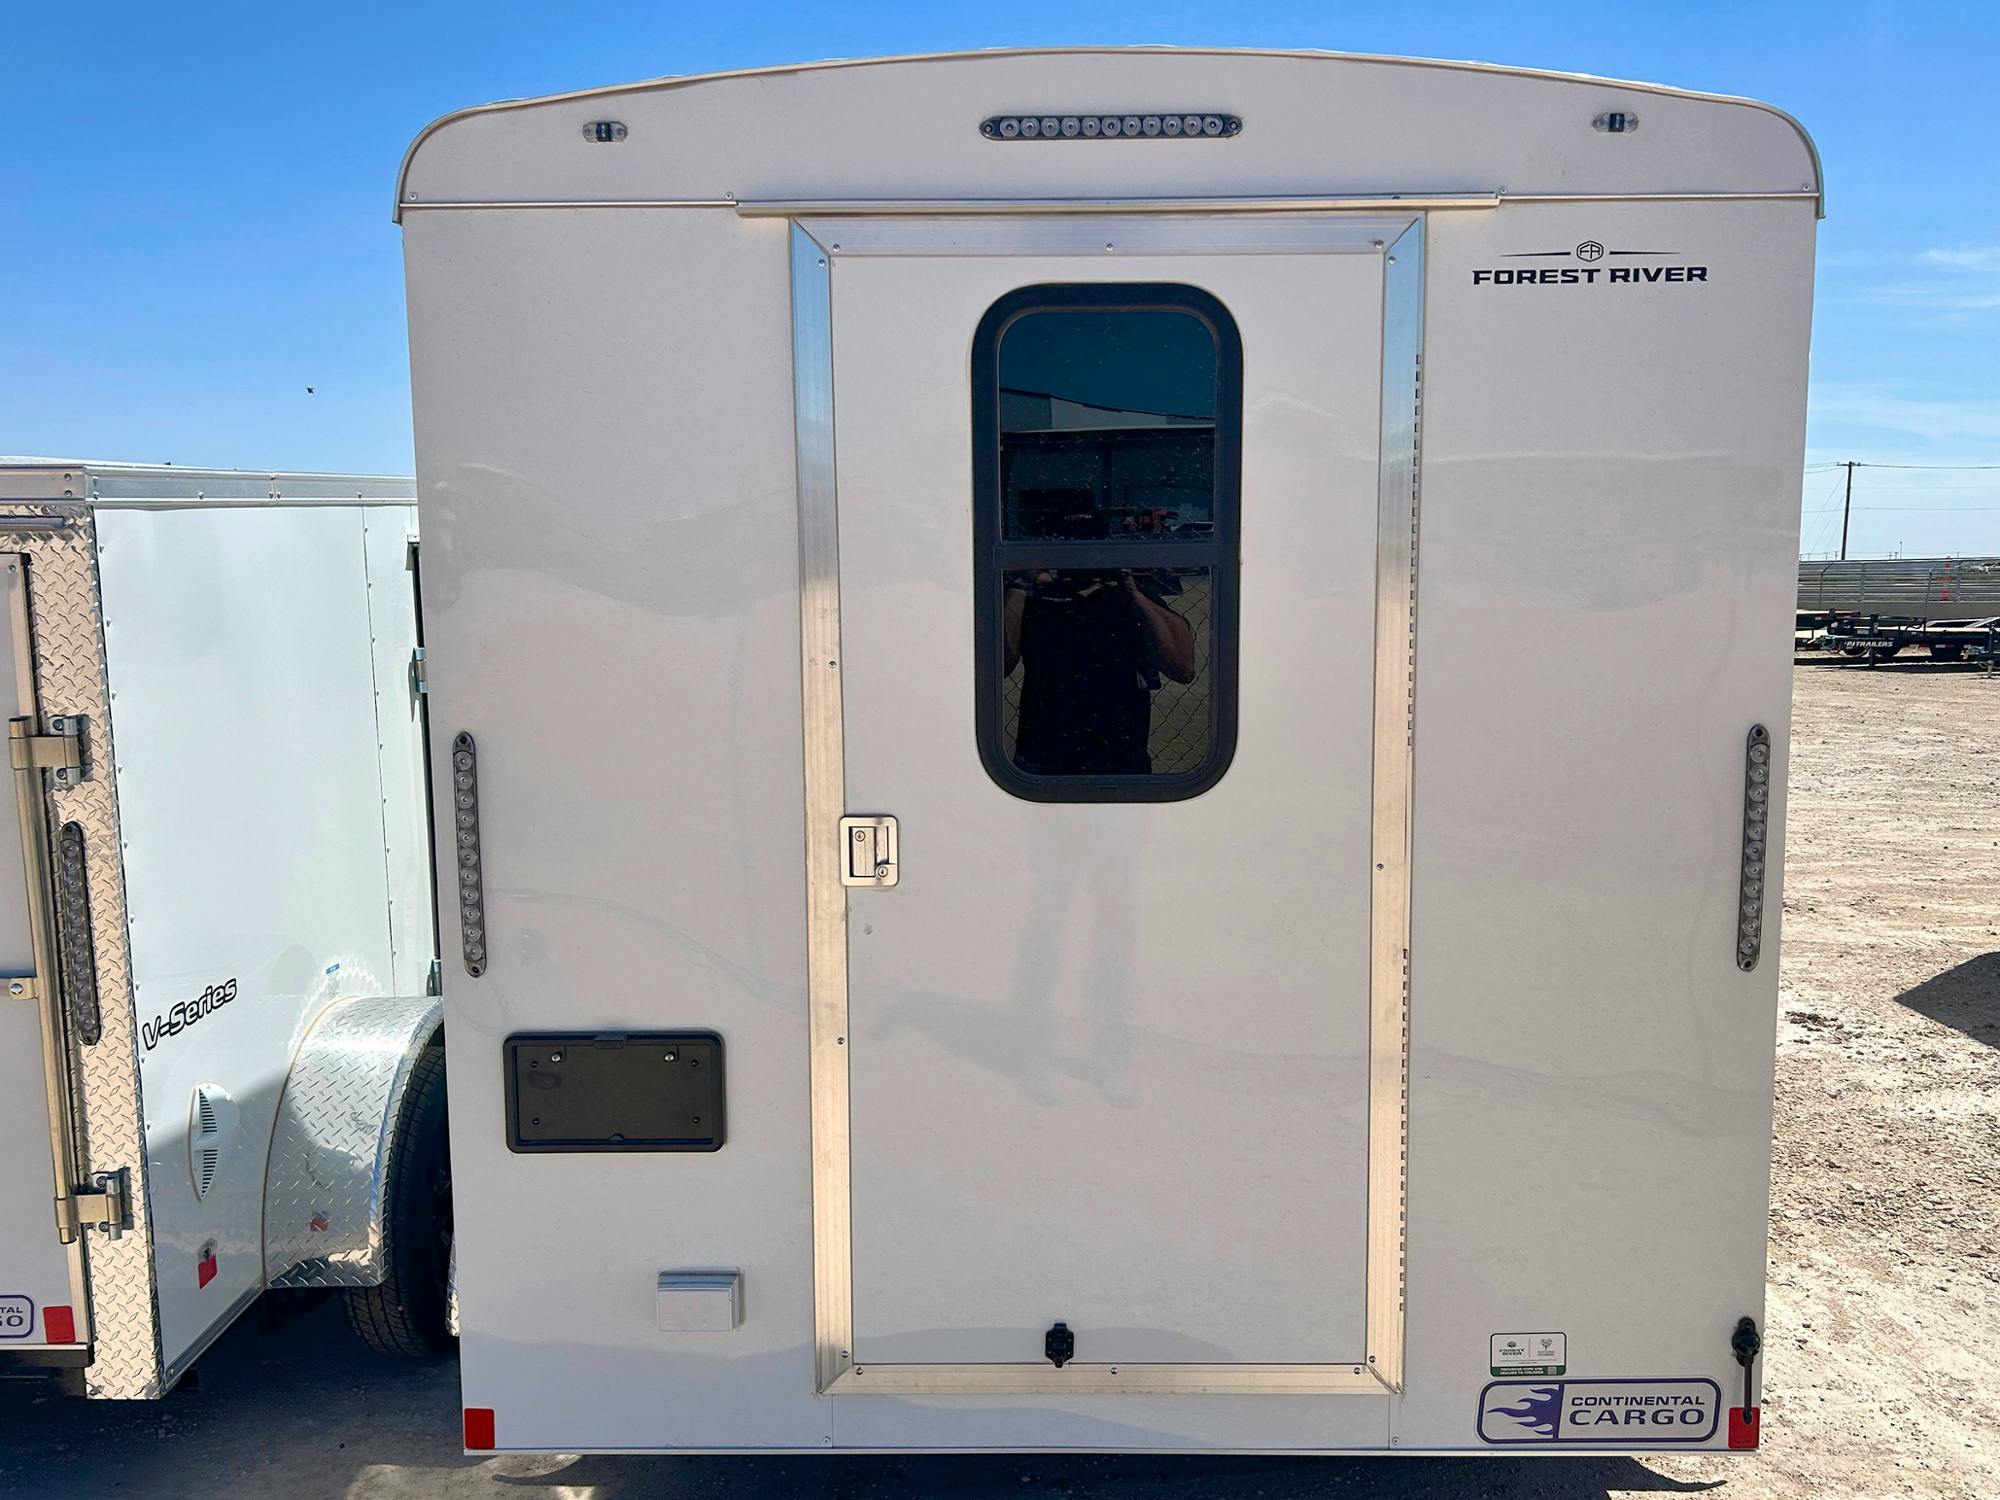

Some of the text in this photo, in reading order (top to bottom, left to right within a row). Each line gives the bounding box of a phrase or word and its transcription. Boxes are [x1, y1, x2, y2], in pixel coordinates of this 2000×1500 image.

[1472, 266, 1708, 286] FOREST RIVER
[142, 978, 237, 1051] V-Series
[1571, 1396, 1705, 1407] CONTINENTAL
[1569, 1408, 1705, 1426] CARGO
